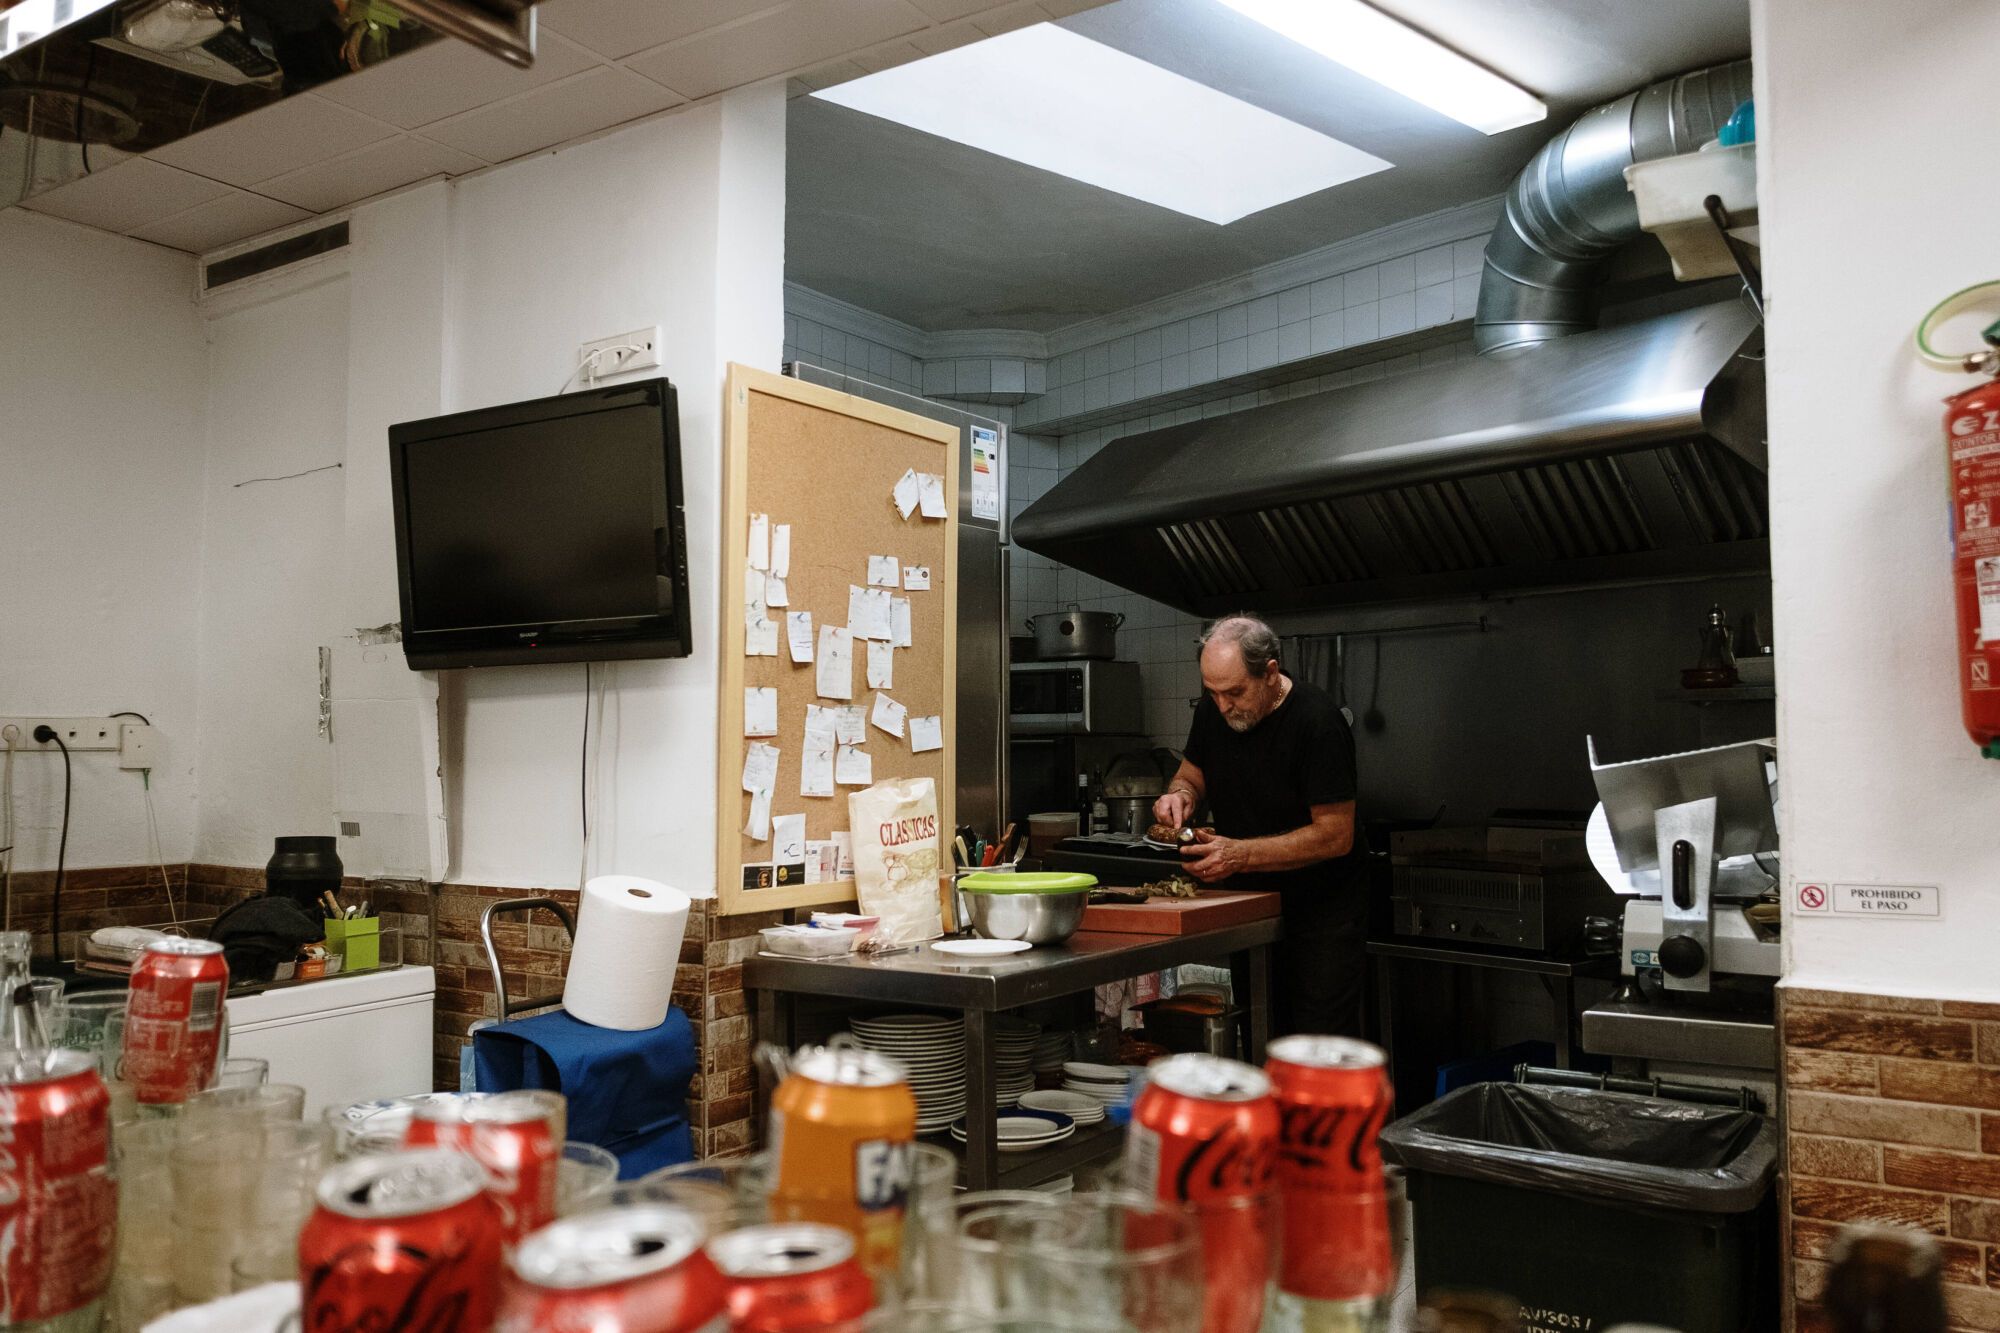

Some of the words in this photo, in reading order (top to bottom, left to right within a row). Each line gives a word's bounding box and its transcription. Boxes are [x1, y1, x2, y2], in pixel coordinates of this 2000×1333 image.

[880, 815, 936, 847] CLASSICAS
[1850, 888, 1922, 900] PROHIBIDO
[1861, 900, 1873, 910] EL
[1877, 901, 1908, 911] PASO
[1518, 1306, 1581, 1328] AVISOS
